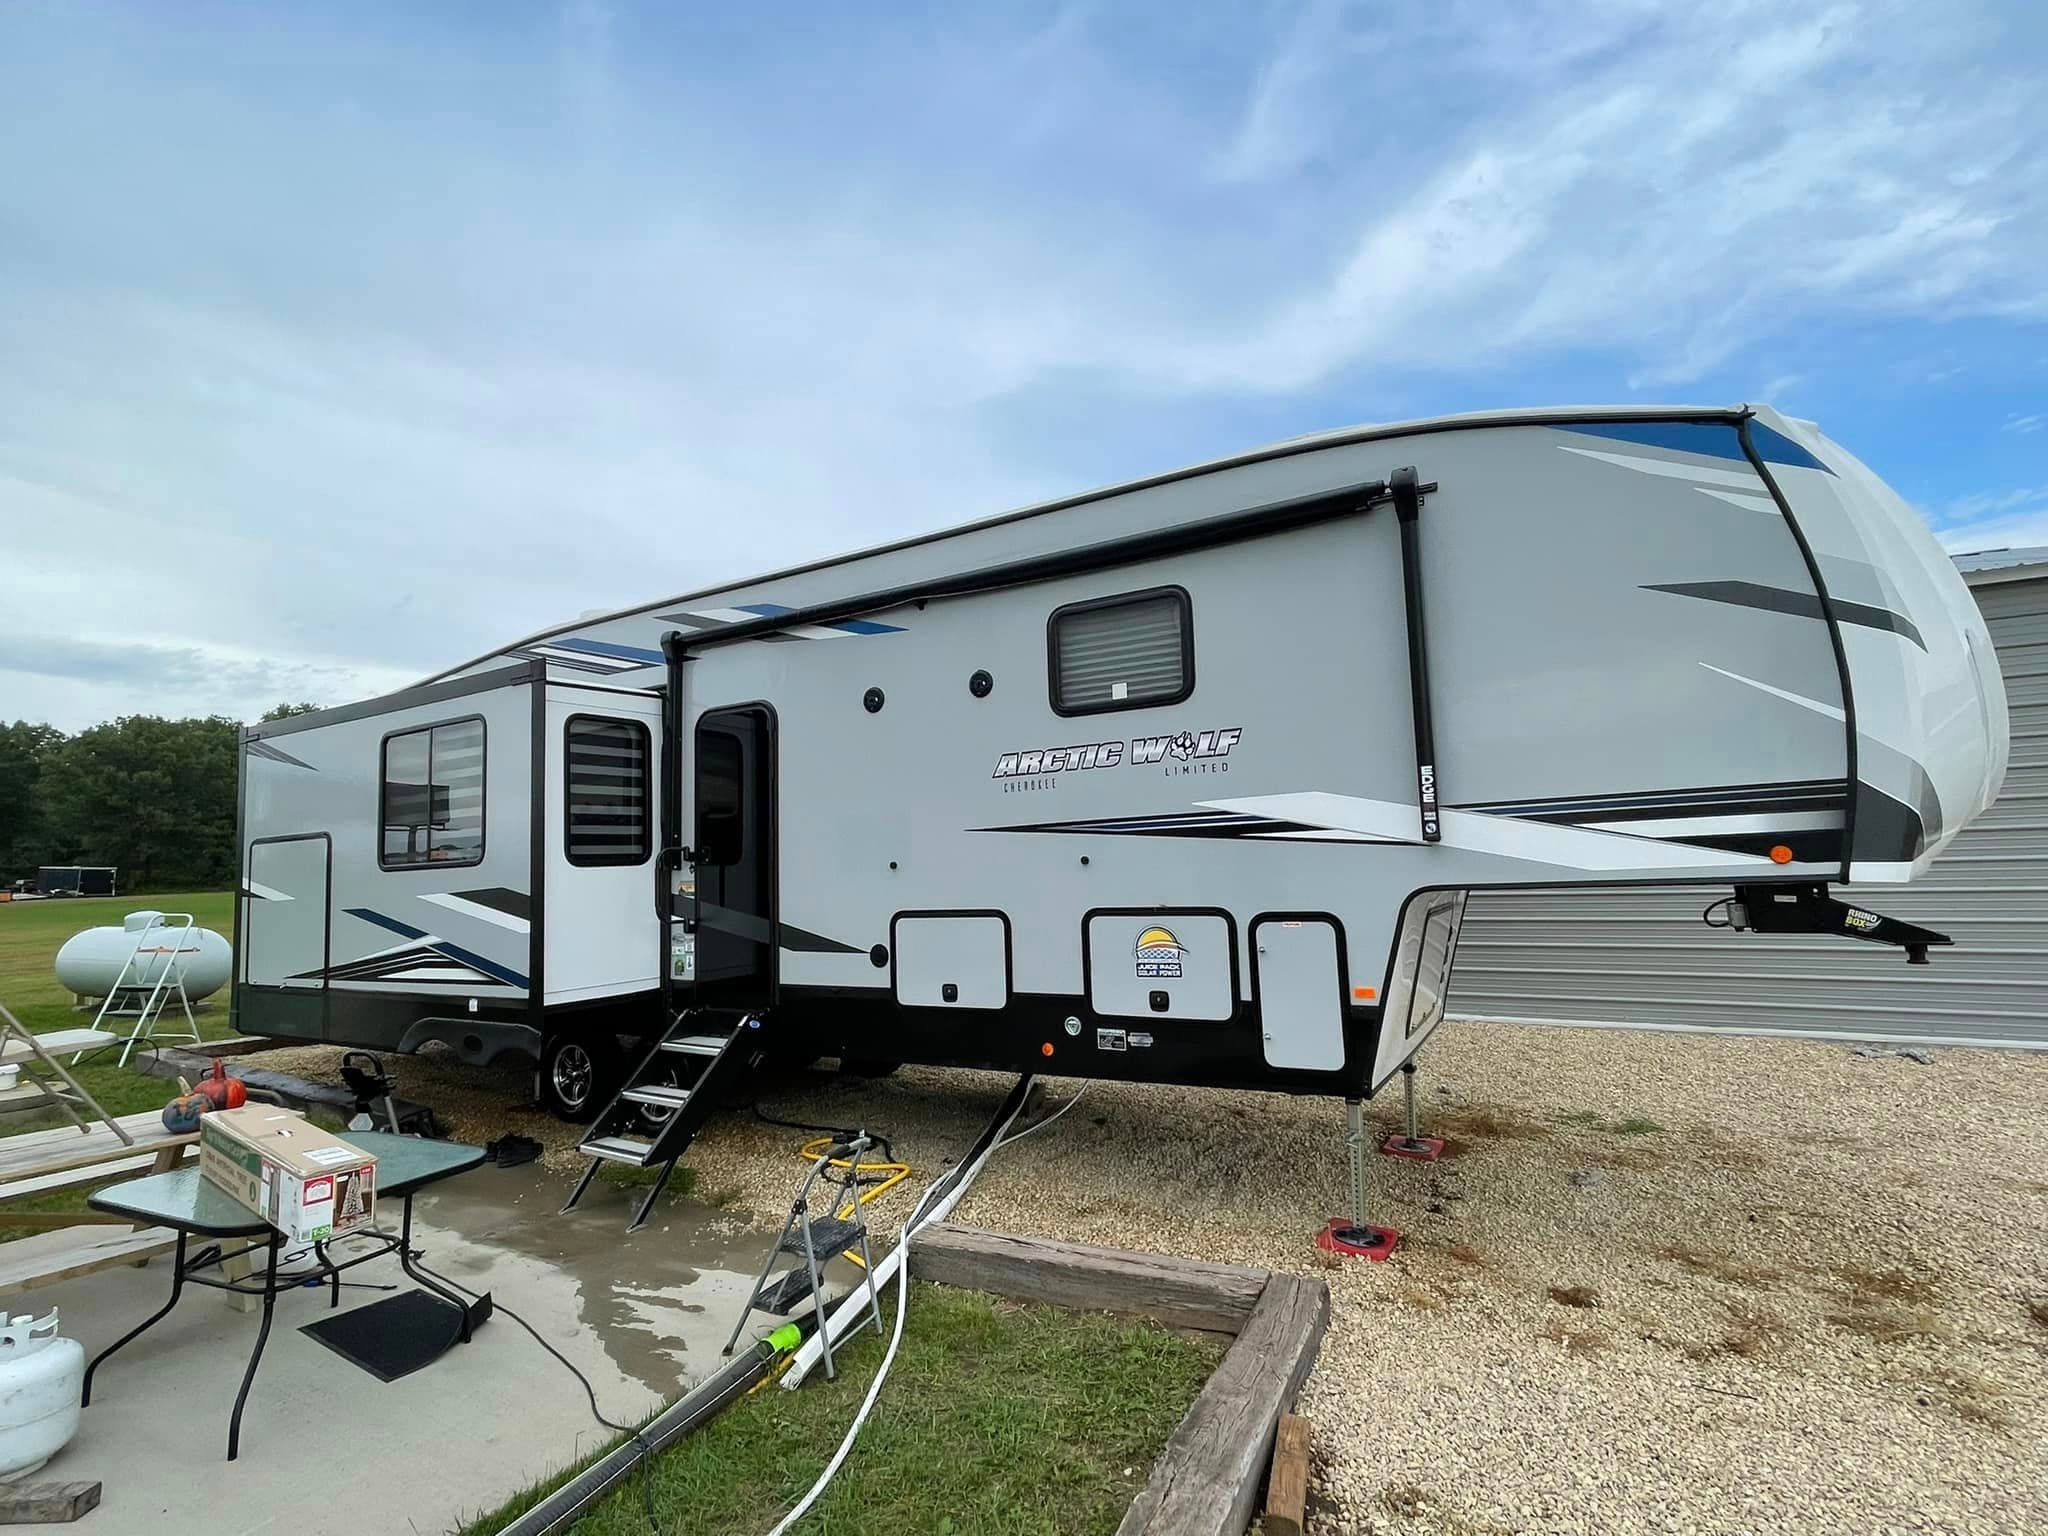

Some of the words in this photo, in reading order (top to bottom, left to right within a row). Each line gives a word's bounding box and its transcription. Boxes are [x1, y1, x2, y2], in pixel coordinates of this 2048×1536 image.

[992, 740, 1124, 778] ARCTIC
[1165, 762, 1228, 777] LIMITED
[1003, 778, 1056, 793] CHEROKEE
[1420, 765, 1435, 802] EDGE
[1845, 915, 1866, 927] BOX
[1848, 908, 1877, 923] RHINO
